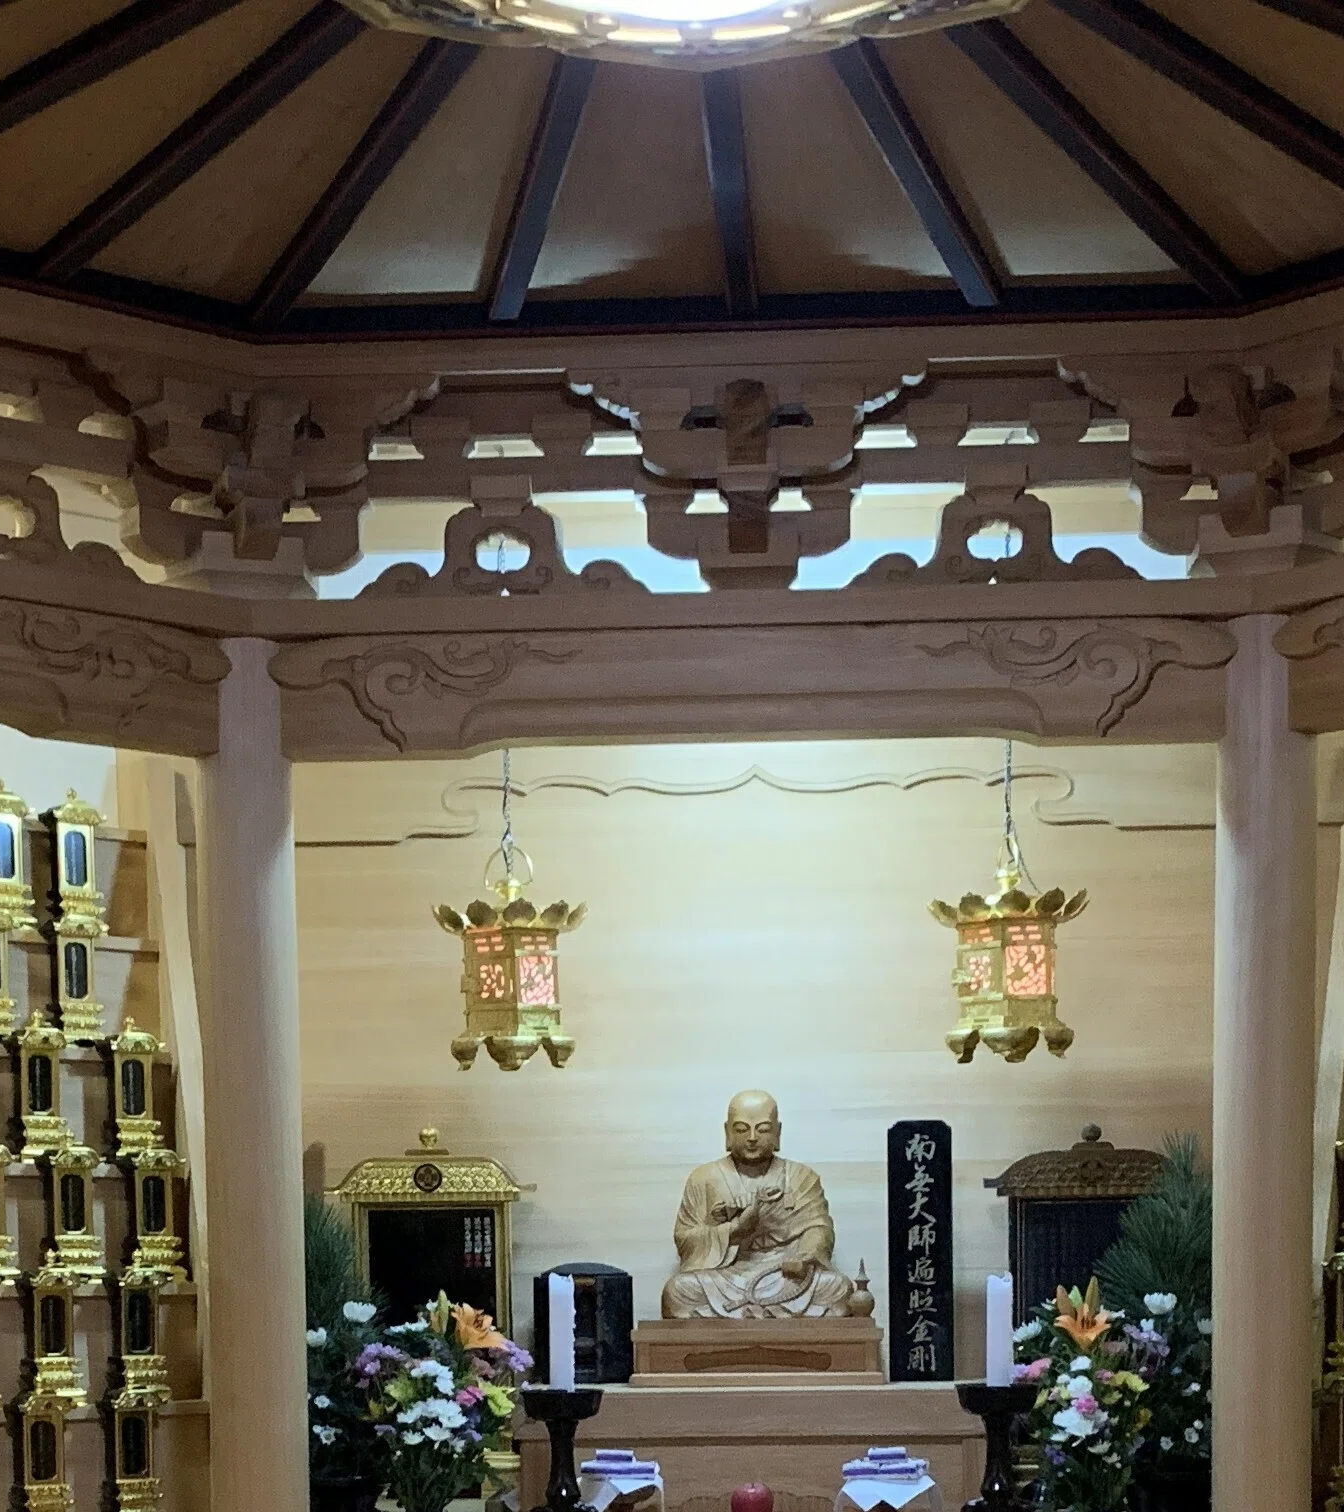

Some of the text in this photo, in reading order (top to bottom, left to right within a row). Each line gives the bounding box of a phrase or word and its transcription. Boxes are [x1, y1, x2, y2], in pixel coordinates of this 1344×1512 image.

[905, 1134, 937, 1372] 南無大師遍照金剛
